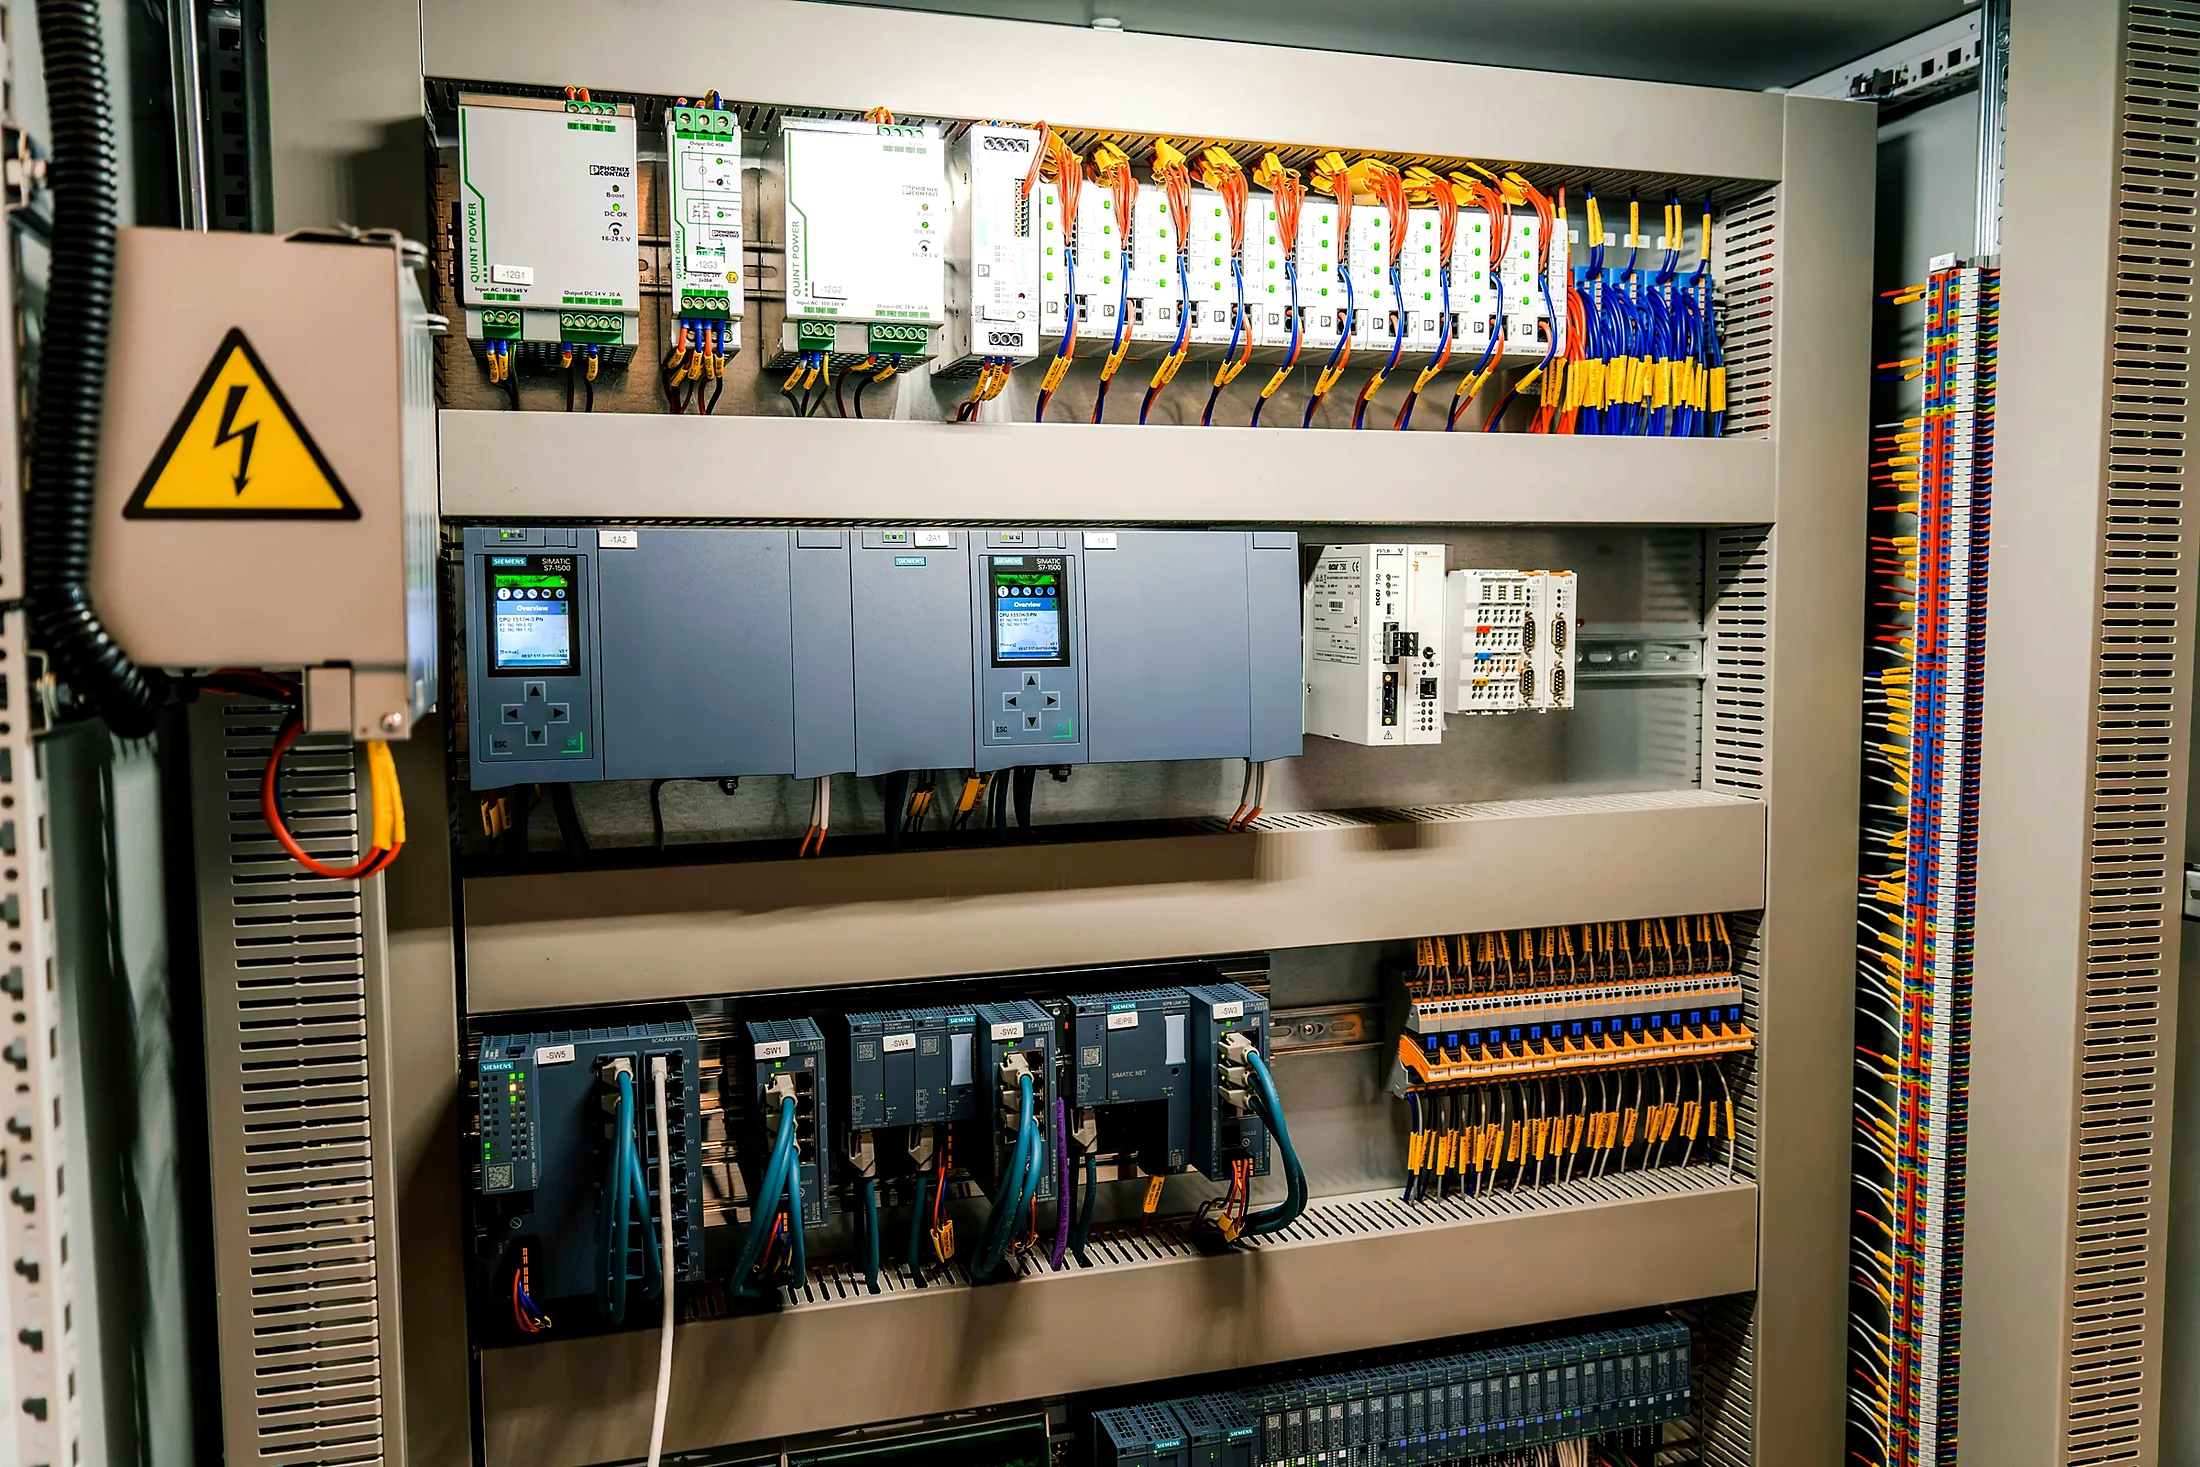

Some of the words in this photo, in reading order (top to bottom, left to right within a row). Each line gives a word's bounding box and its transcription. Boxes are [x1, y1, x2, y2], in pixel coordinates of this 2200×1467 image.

[468, 202, 477, 244] POWER
[792, 221, 800, 259] POWER
[470, 246, 480, 283] QUINT
[696, 261, 718, 269] -12G3
[502, 270, 525, 280] -12G1
[821, 286, 842, 294] -12G2
[609, 535, 627, 544] -1A2
[494, 740, 507, 748] ESC
[1027, 1021, 1053, 1029] SCALANCE
[1113, 1017, 1133, 1025] -IE/PB
[1000, 1027, 1018, 1035] -SW2
[651, 1036, 679, 1044] SCALANCE
[546, 1050, 566, 1060] -SW5
[763, 1047, 782, 1055] -SW1
[1230, 1429, 1253, 1437] SIEMENS
